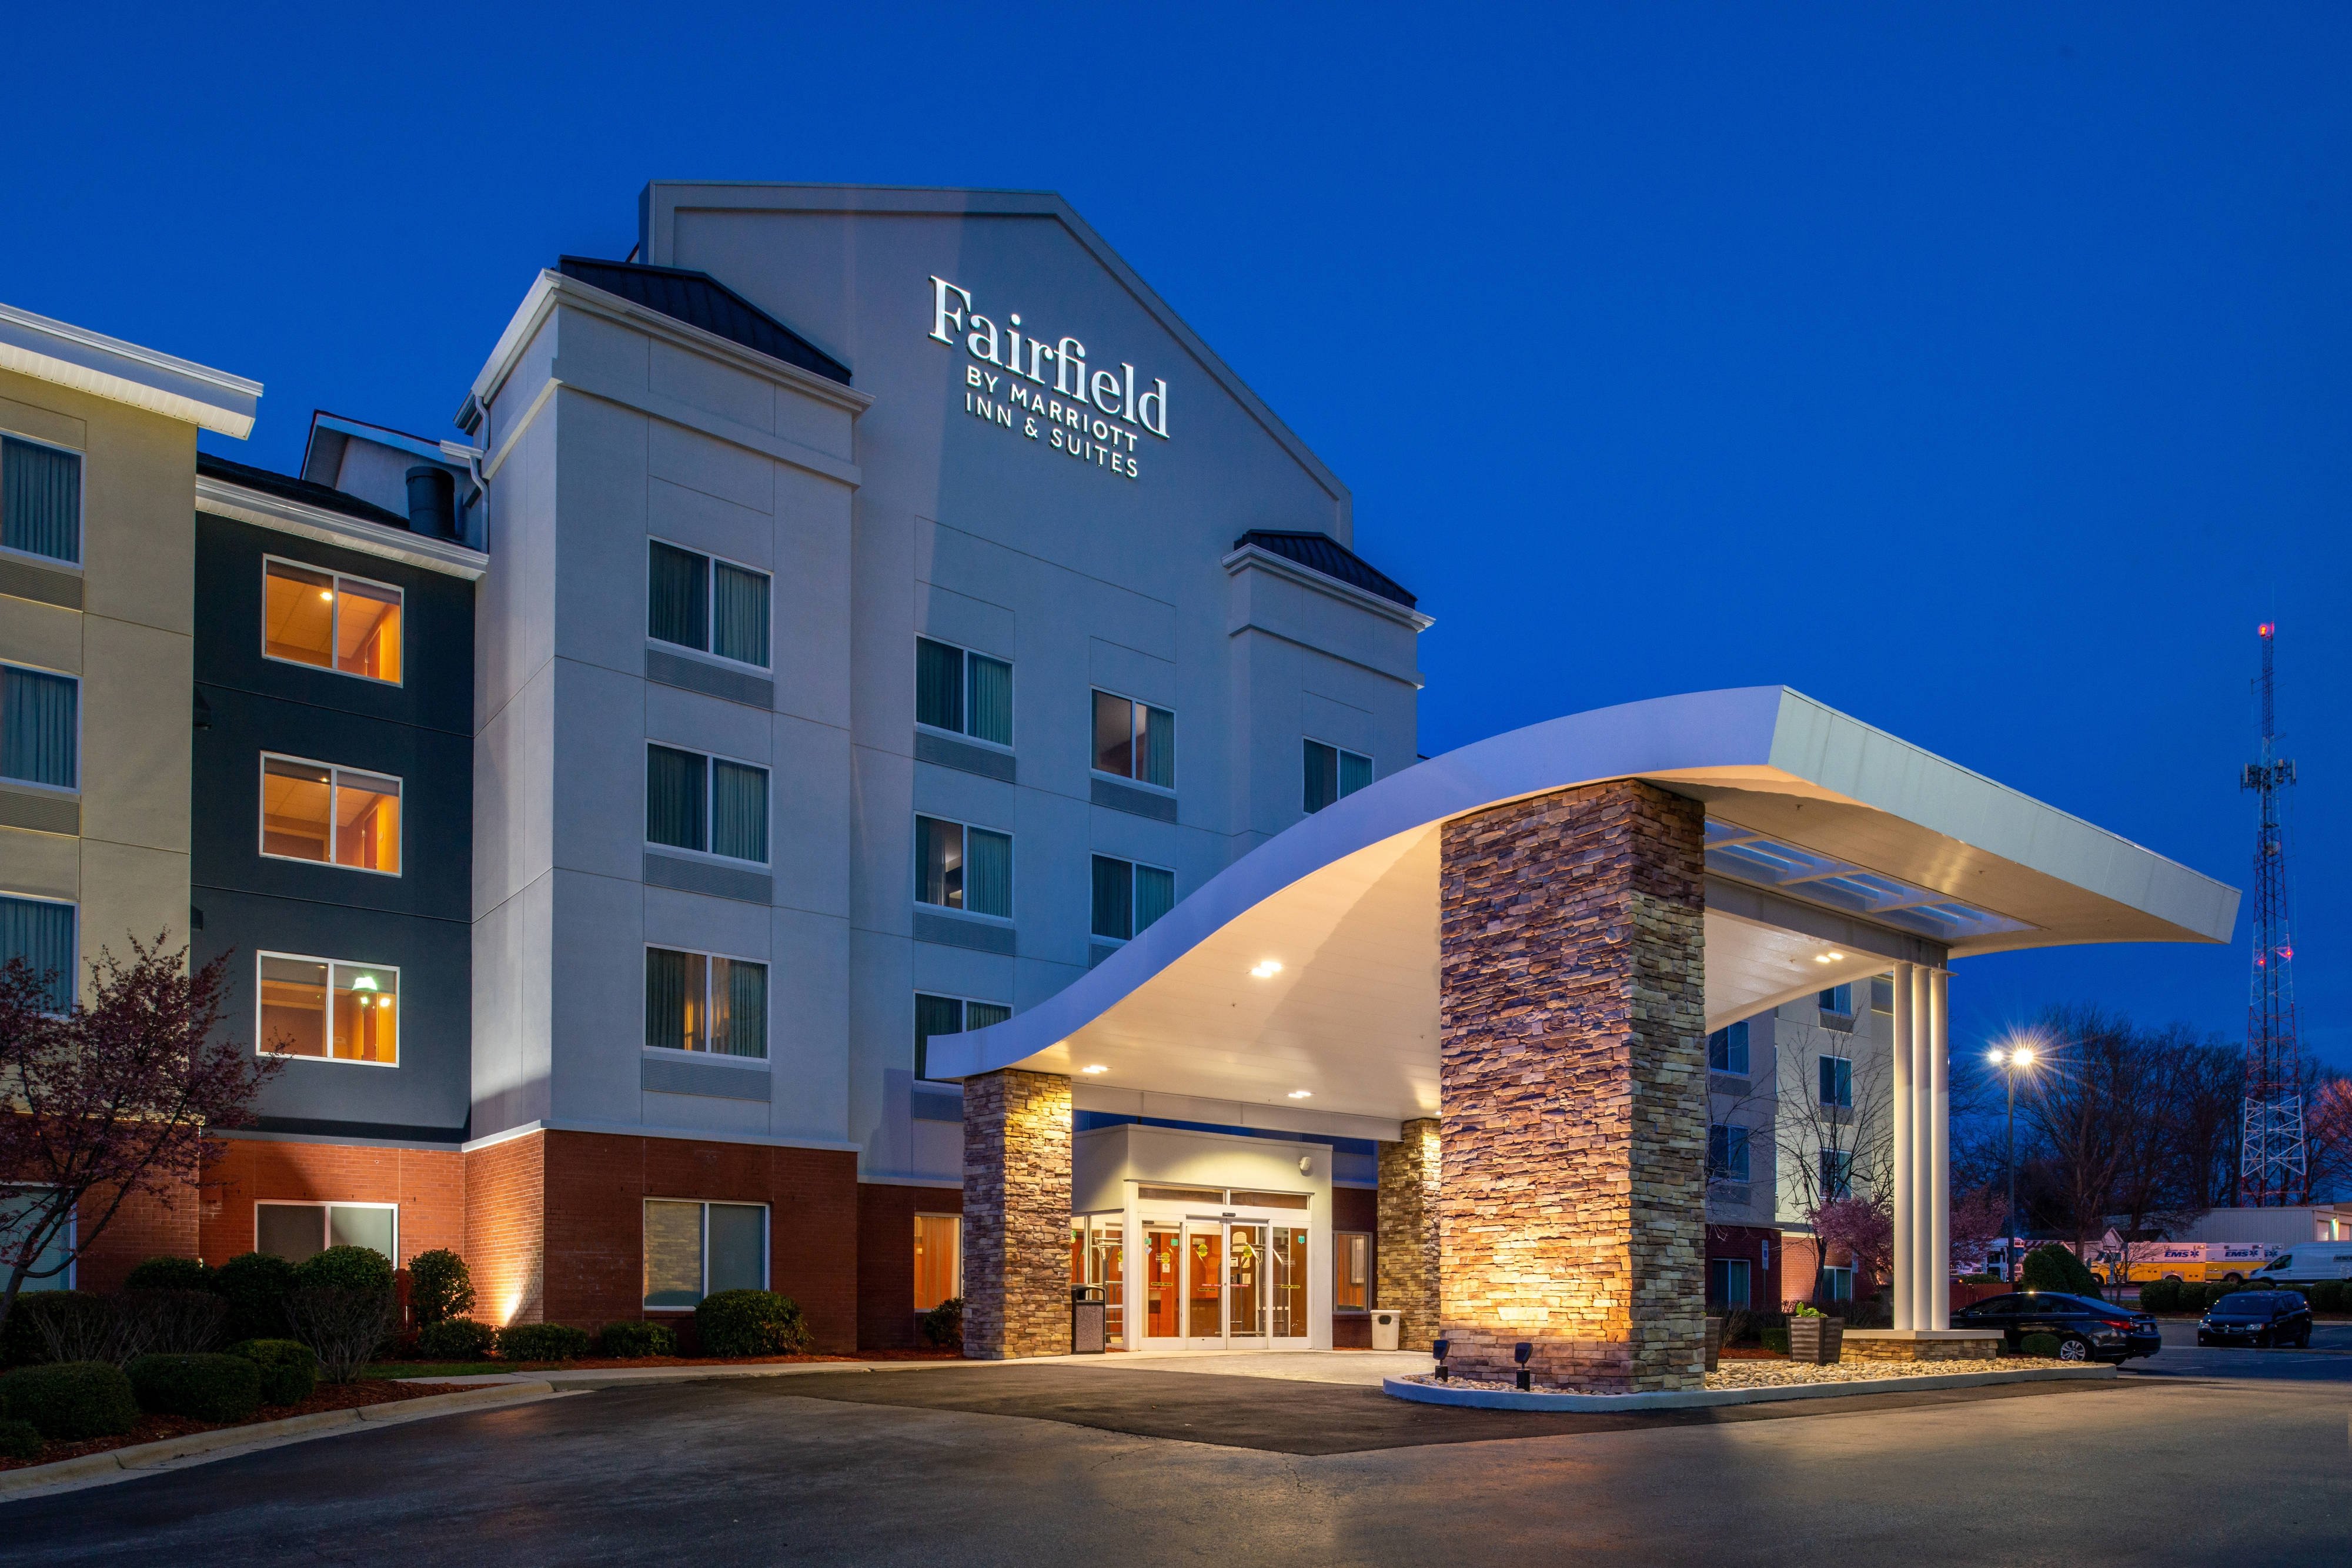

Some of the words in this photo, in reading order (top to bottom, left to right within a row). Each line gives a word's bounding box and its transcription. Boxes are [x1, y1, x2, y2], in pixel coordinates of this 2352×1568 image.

[928, 275, 1170, 440] Fairfield
[965, 365, 999, 394] BY
[1009, 383, 1138, 453] MARRIOTT
[965, 392, 1012, 429] INN
[1023, 417, 1038, 440] &
[1049, 428, 1138, 479] SUITES
